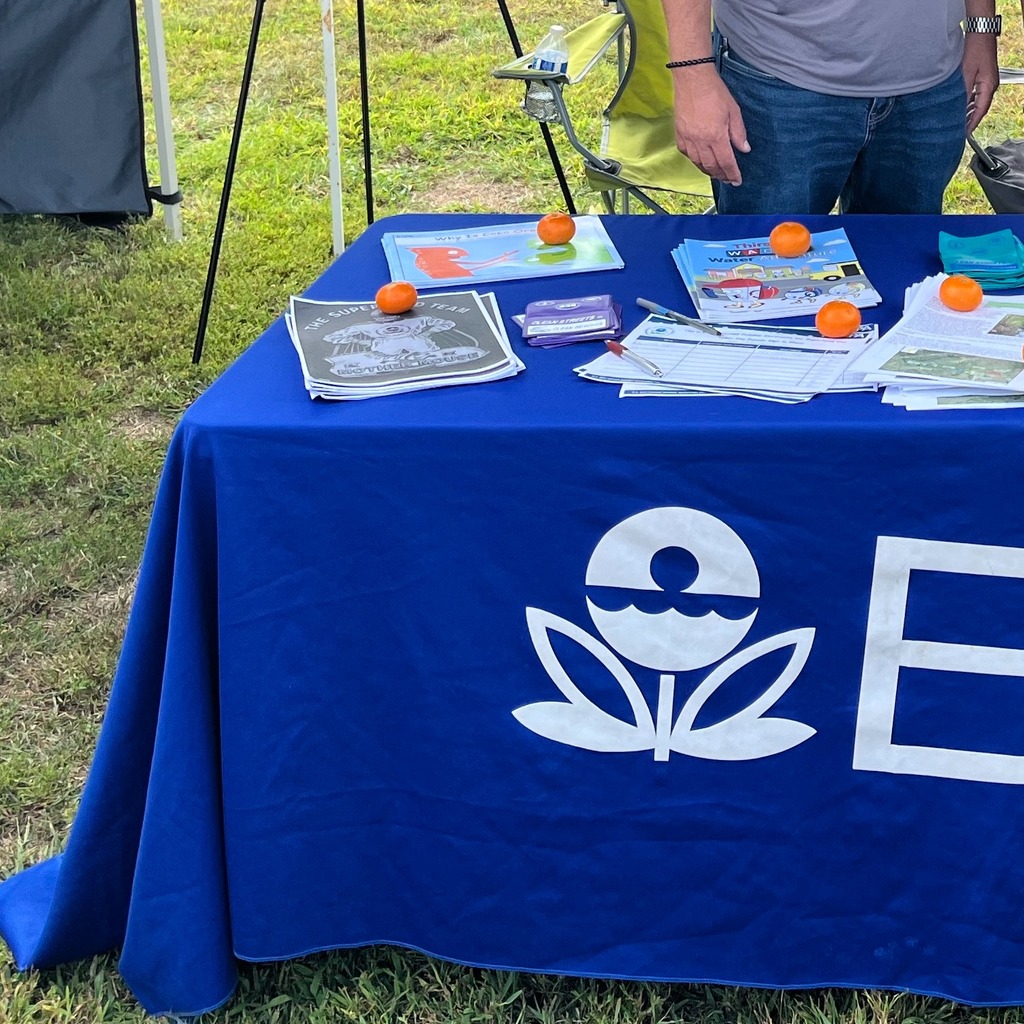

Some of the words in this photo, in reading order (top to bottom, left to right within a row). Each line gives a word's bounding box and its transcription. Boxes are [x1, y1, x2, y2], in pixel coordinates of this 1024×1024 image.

[304, 317, 330, 331] THE
[430, 303, 471, 314] TEAM
[560, 315, 596, 324] STREETS
